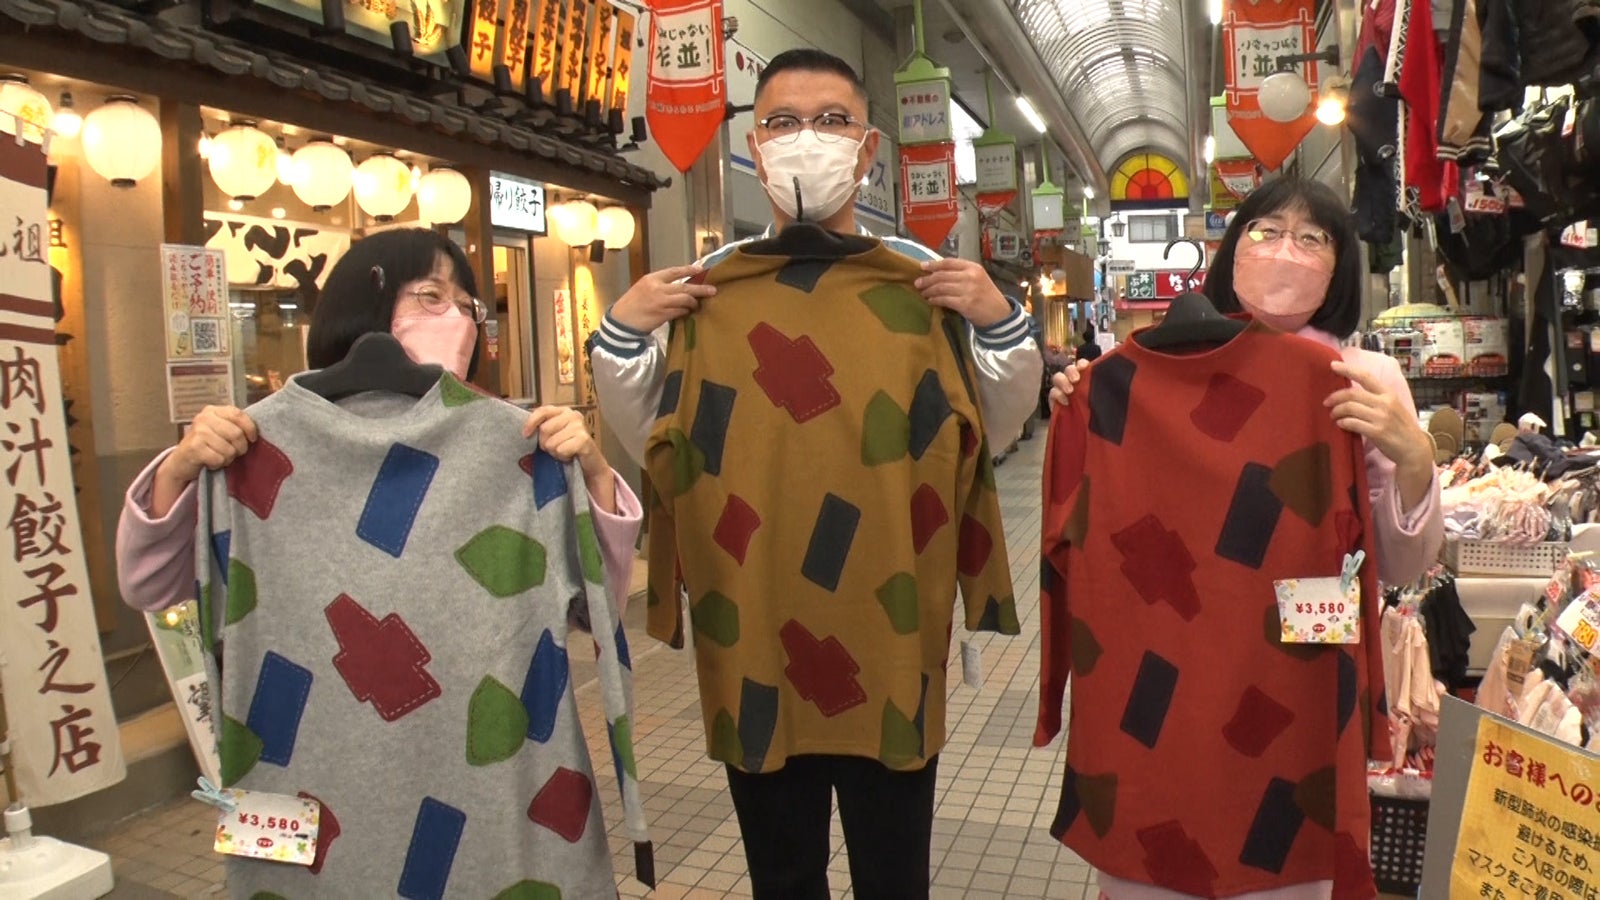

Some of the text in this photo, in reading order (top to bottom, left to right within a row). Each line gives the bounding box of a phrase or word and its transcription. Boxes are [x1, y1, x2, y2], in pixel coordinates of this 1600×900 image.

[911, 180, 947, 196] 杉並!
[0, 215, 46, 265] 祖
[0, 346, 101, 778] 肉汁餃子之店
[1296, 603, 1344, 615] ¥3,580
[1483, 741, 1600, 813] お客様への
[239, 813, 299, 831] ¥3,580
[1516, 823, 1593, 874] 避けるため、
